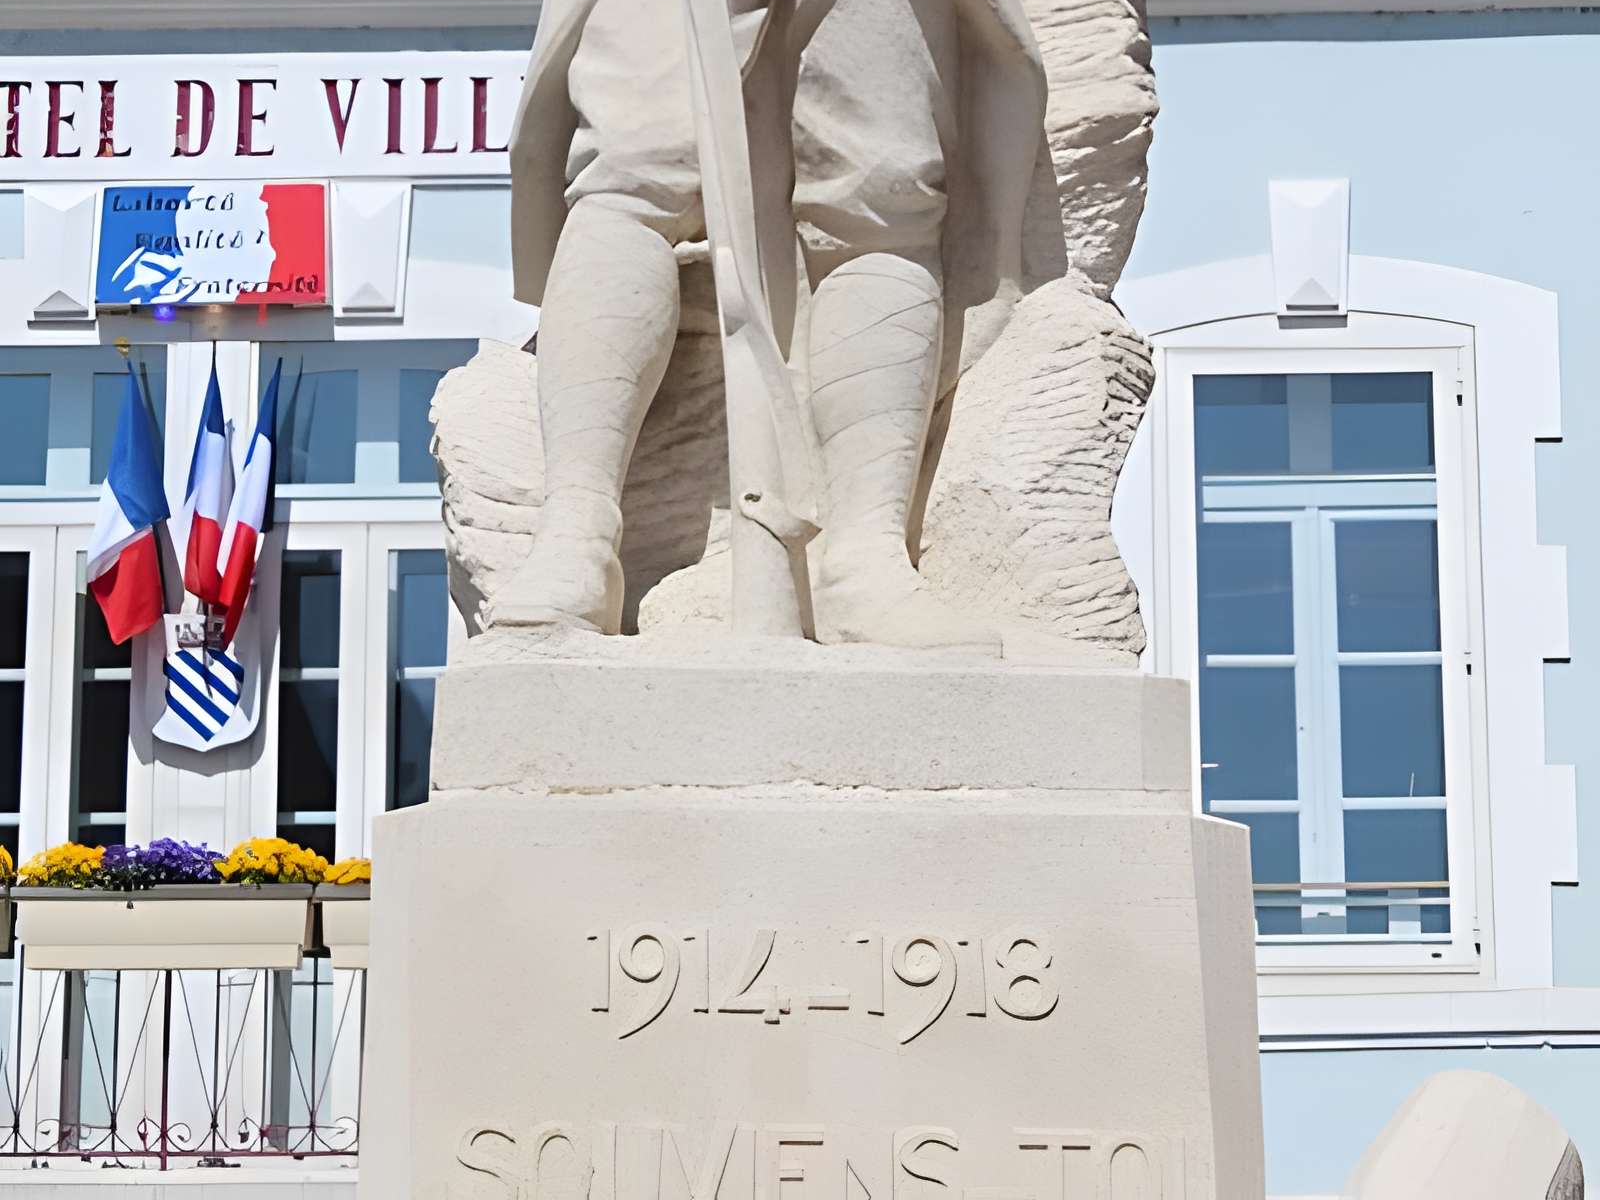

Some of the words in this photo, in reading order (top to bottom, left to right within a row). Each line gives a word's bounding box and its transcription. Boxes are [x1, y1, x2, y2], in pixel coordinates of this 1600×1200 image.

[0, 80, 132, 158] TEL
[171, 79, 278, 157] DE
[321, 76, 524, 154] VILL
[585, 924, 1061, 1046] 1914-1918
